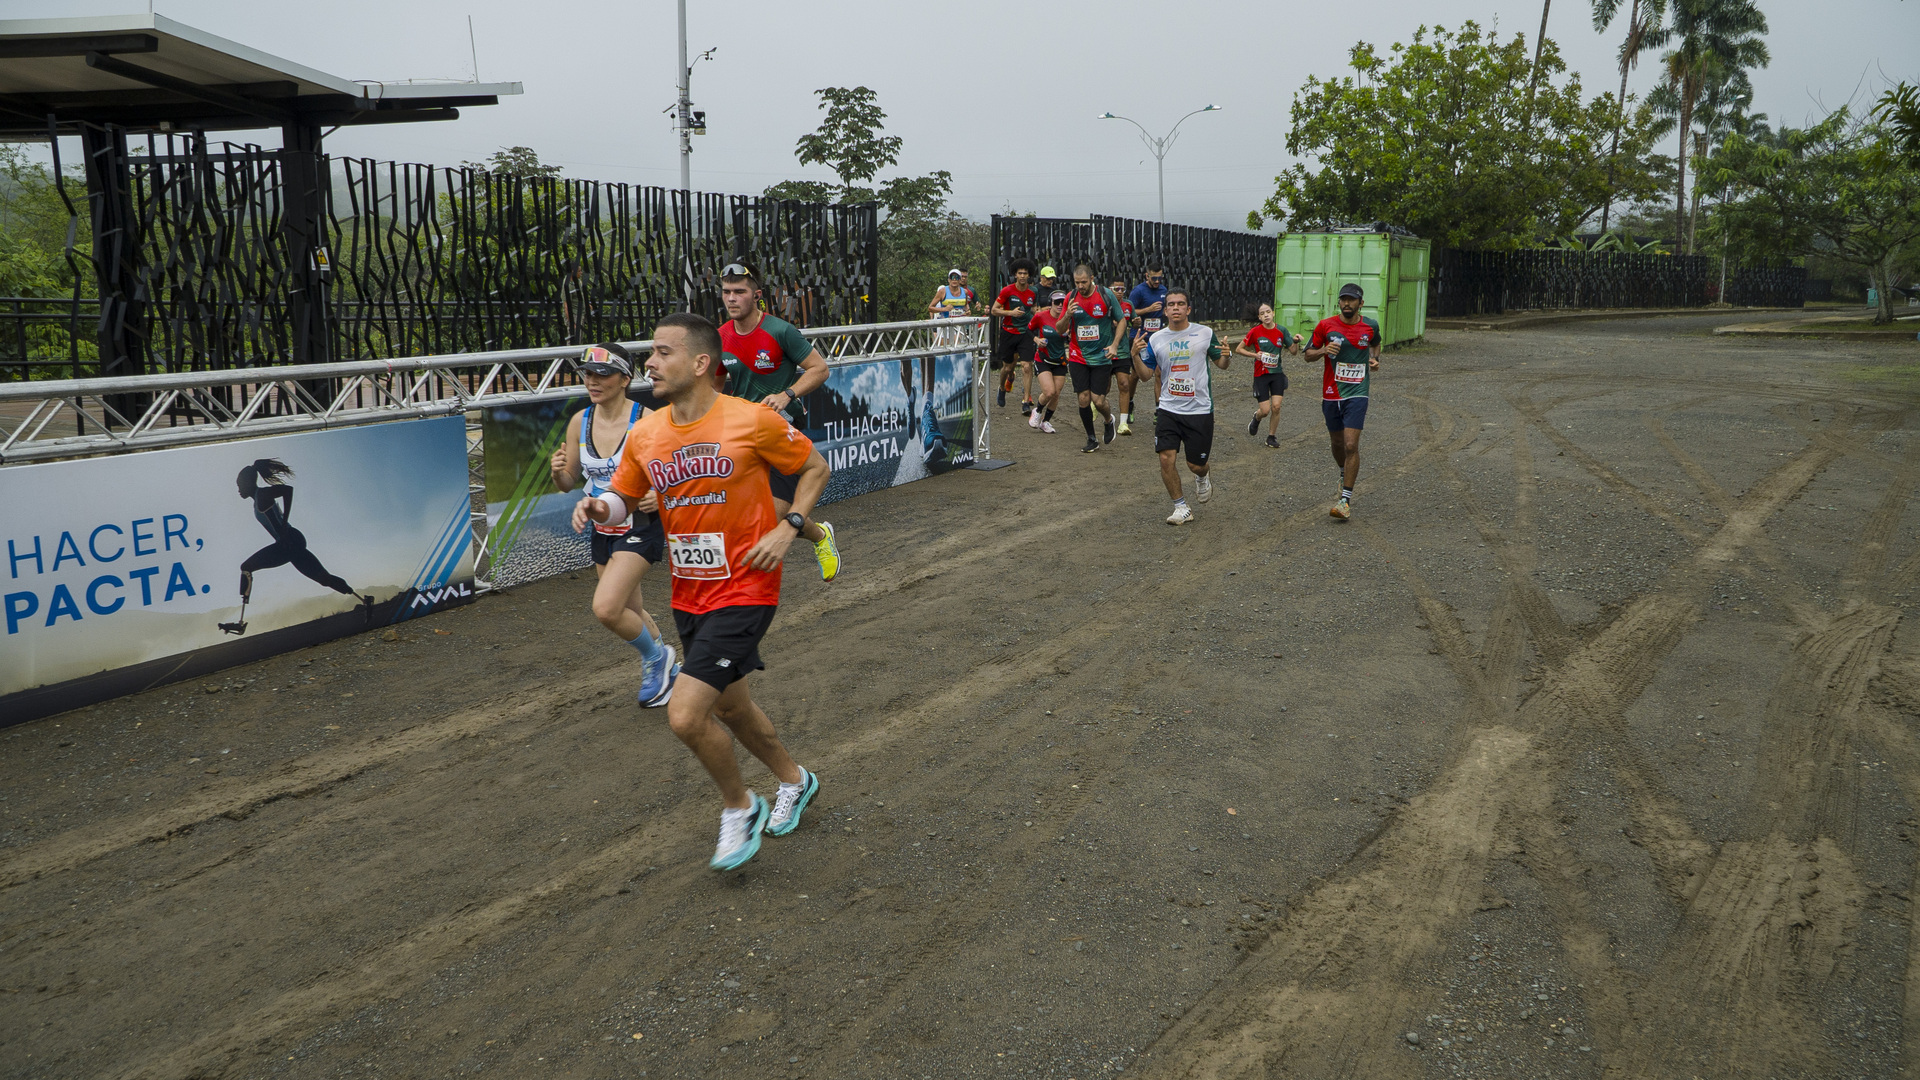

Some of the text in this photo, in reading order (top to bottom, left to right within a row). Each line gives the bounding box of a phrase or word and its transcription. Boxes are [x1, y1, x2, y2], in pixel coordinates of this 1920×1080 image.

[1341, 369, 1360, 377] 1777
[1170, 383, 1190, 392] 2036
[824, 420, 844, 444] TU
[850, 410, 903, 440] HACER,
[828, 436, 903, 472] IMPACTA.
[952, 451, 974, 465] AVAL
[647, 454, 734, 493] Bakano
[690, 490, 726, 506] carnita!
[7, 513, 204, 579] HACER,
[673, 548, 714, 566] 1230
[410, 582, 472, 609] AVAL
[417, 581, 442, 592] Grupo
[4, 561, 211, 635] PACTA.
